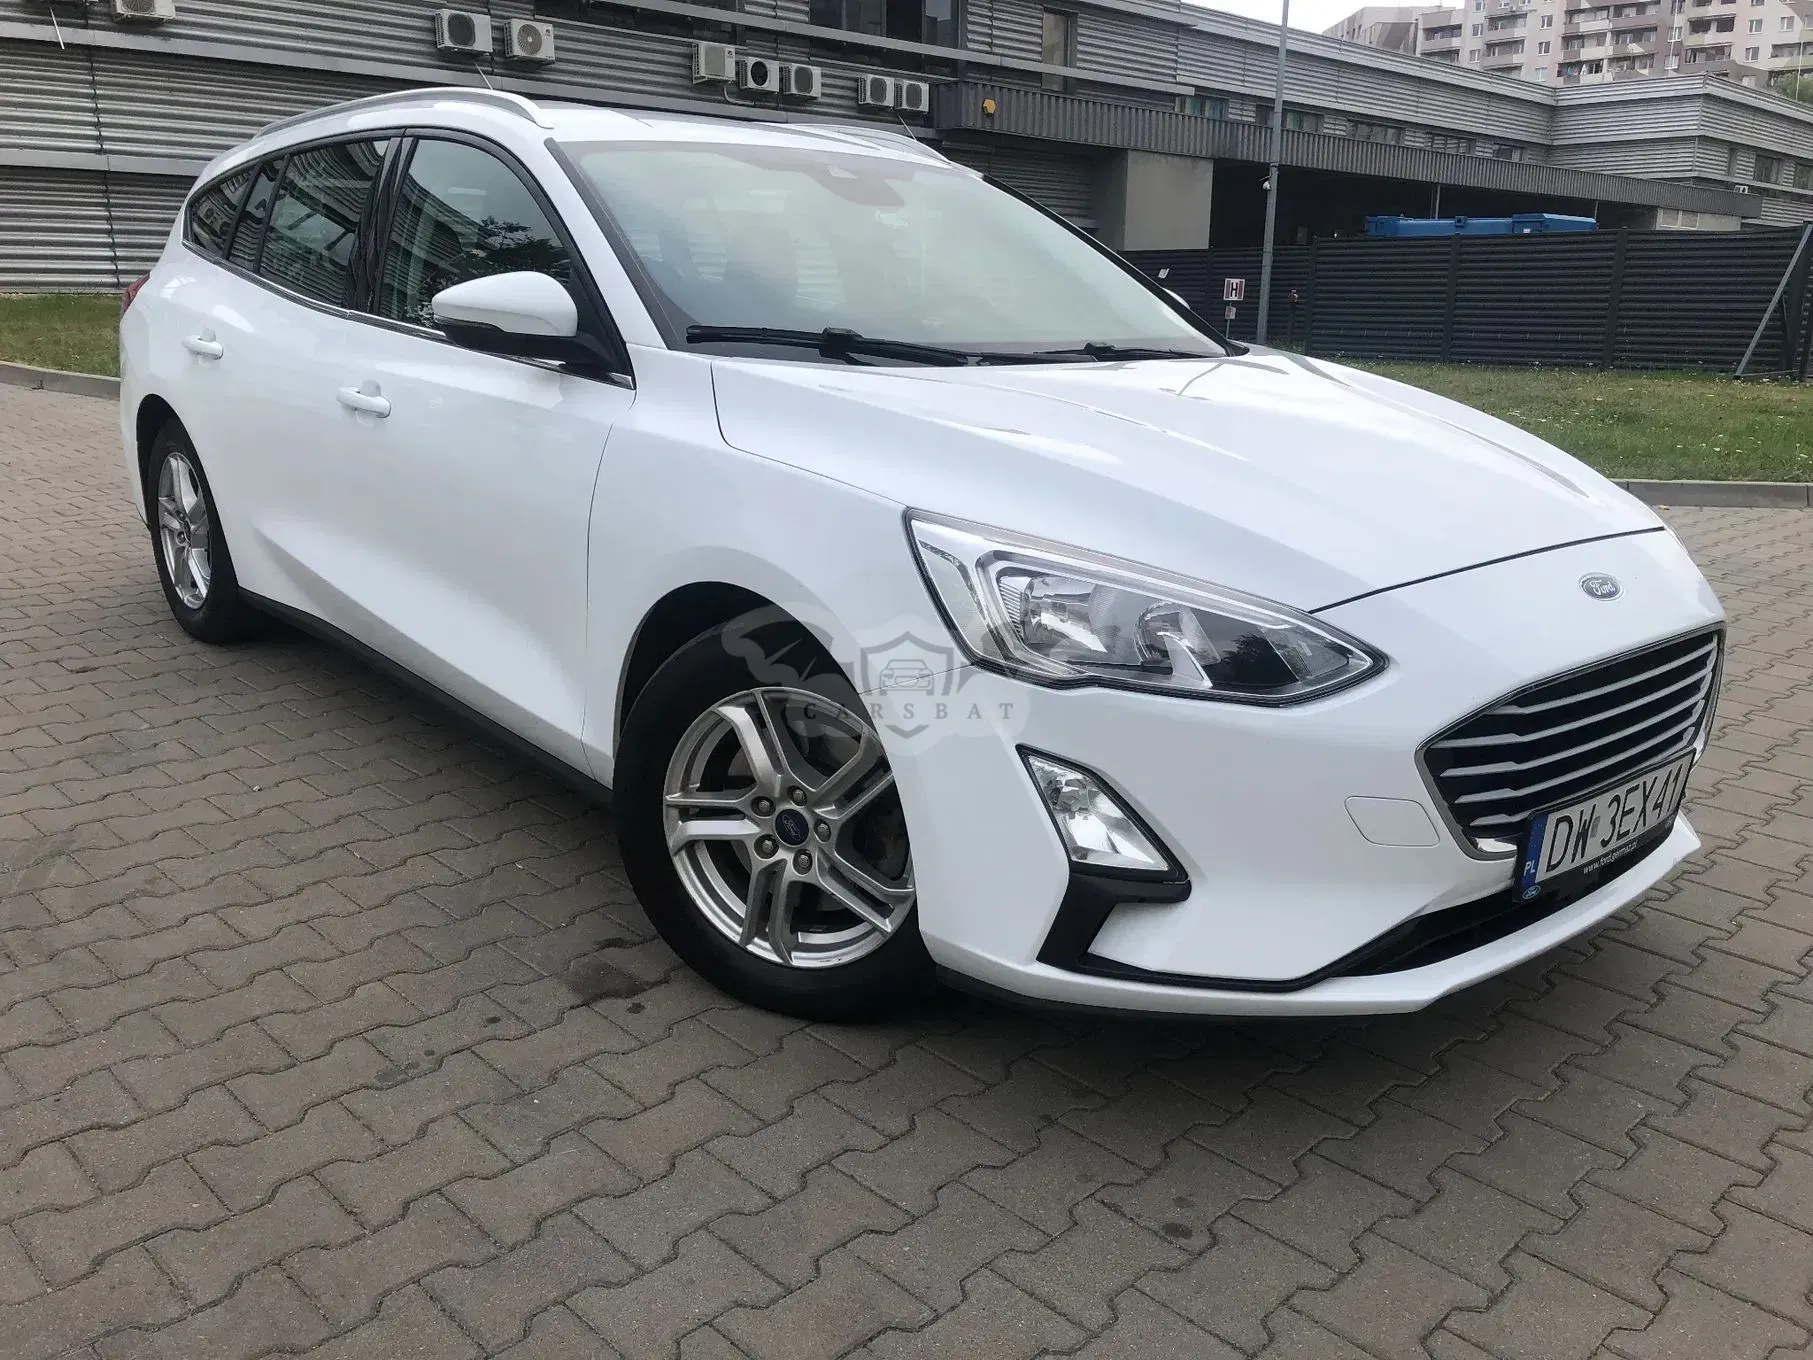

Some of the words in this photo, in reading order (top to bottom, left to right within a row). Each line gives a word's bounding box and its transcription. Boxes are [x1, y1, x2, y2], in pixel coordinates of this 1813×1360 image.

[1230, 281, 1239, 297] H
[1589, 579, 1616, 596] Ford
[1546, 804, 1597, 873] DW
[1600, 764, 1683, 848] 3EX41
[1523, 859, 1536, 876] PL
